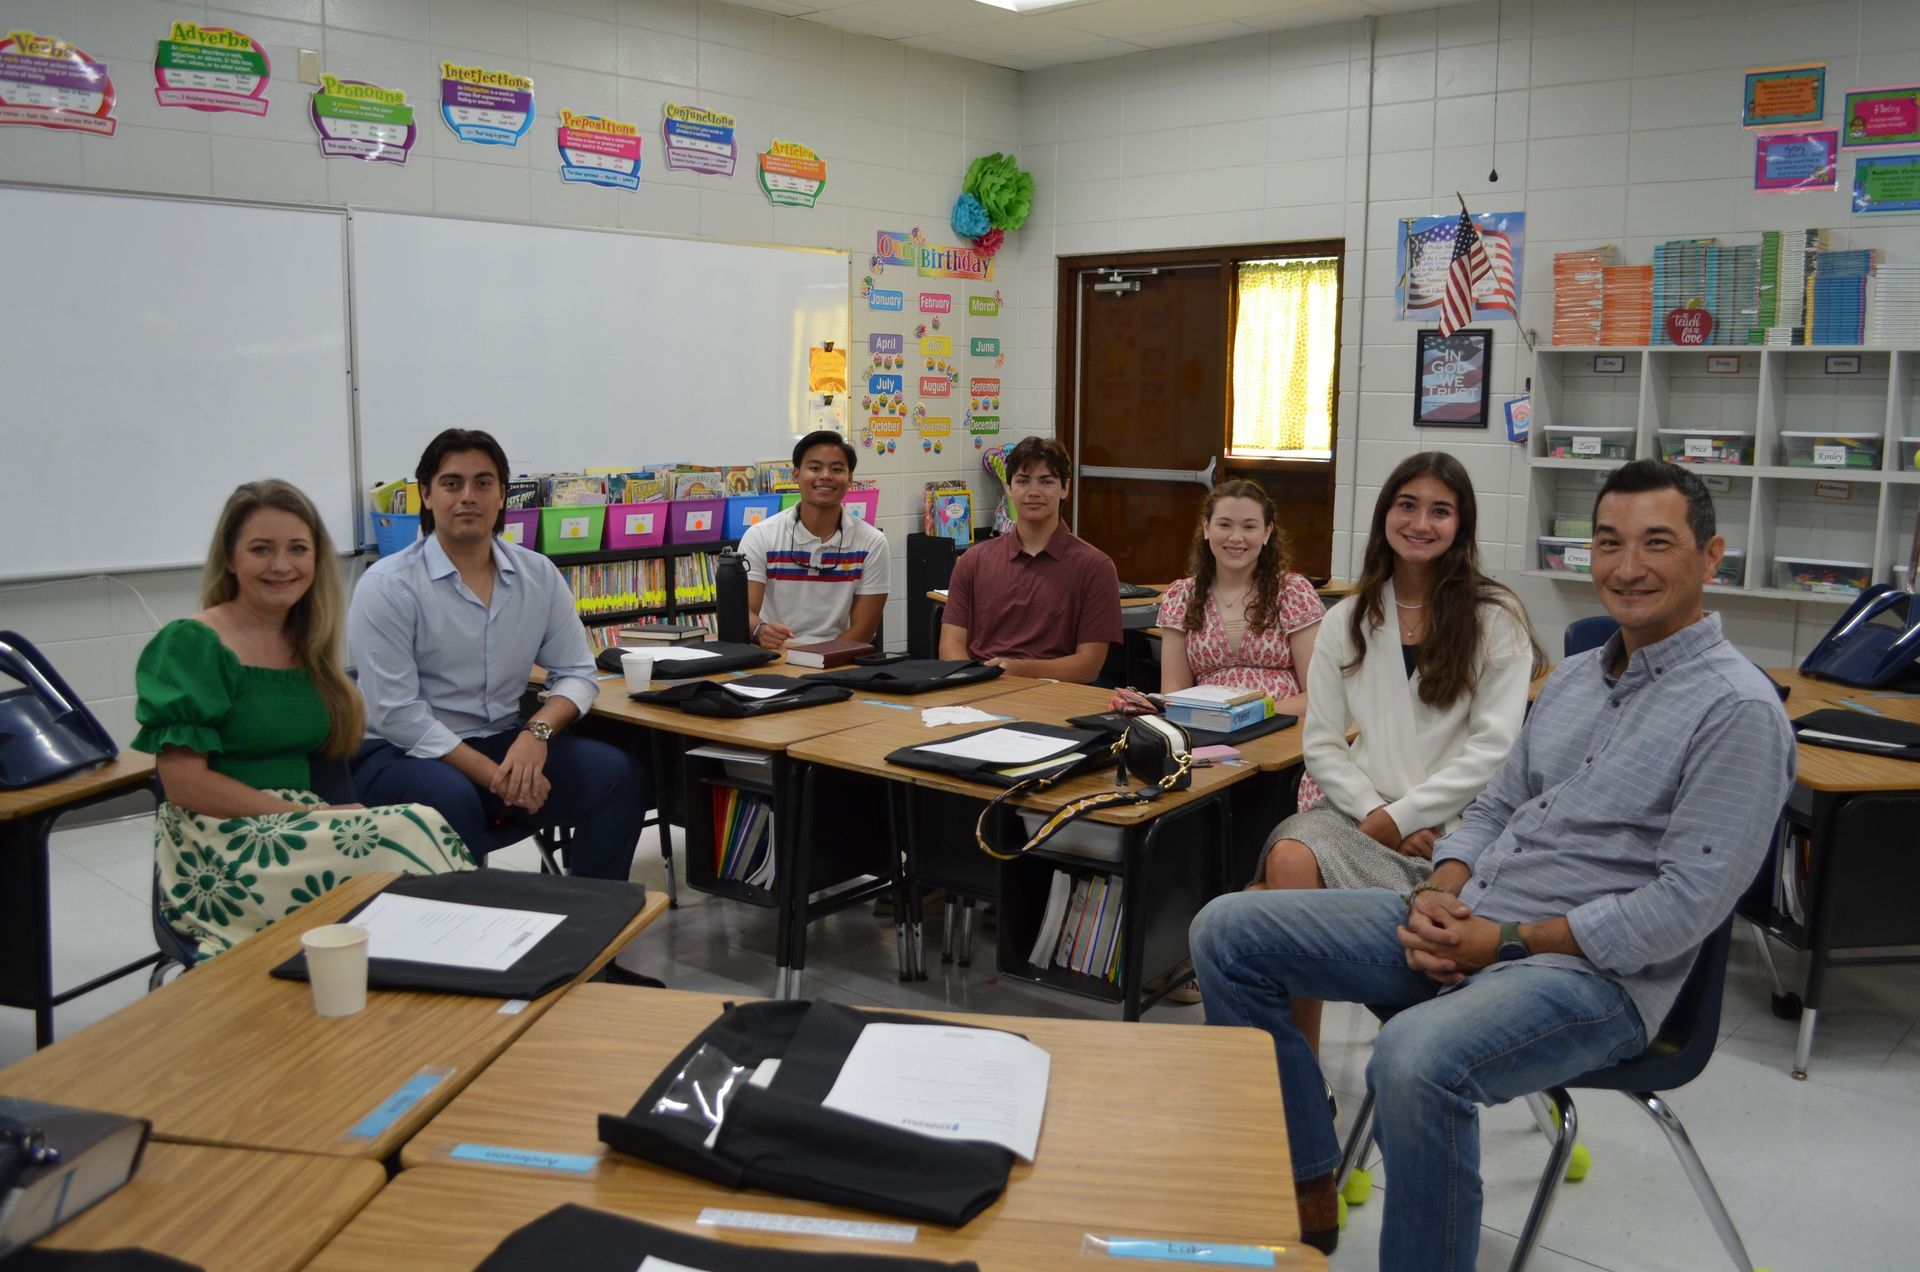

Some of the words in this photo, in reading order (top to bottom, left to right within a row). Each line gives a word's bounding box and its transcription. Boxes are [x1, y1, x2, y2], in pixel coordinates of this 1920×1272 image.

[174, 24, 249, 47] Adverbs
[15, 34, 73, 57] Verbs
[444, 64, 530, 88] Interjections
[323, 76, 403, 103] Pronouns
[667, 104, 734, 126] Conjunctions
[1874, 104, 1901, 115] Poetry
[563, 111, 635, 134] Prepositions
[773, 141, 814, 160] Articles
[879, 236, 911, 257] Our
[921, 248, 991, 278] Birthday
[871, 293, 901, 309] January
[920, 296, 950, 310] February
[972, 299, 995, 312] March
[1681, 327, 1703, 344] love
[876, 338, 896, 351] April
[975, 341, 995, 352] June
[1444, 349, 1462, 362] IN
[1431, 360, 1467, 374] GOD
[876, 378, 895, 390] July
[1441, 374, 1465, 387] WE
[922, 381, 948, 394] August
[970, 381, 1000, 394] September
[1426, 385, 1479, 398] TRUST
[871, 420, 901, 432] October
[970, 420, 1000, 431] December
[1576, 441, 1597, 453] Zoey
[1817, 451, 1843, 463] Kinley
[1568, 554, 1588, 563] Crews
